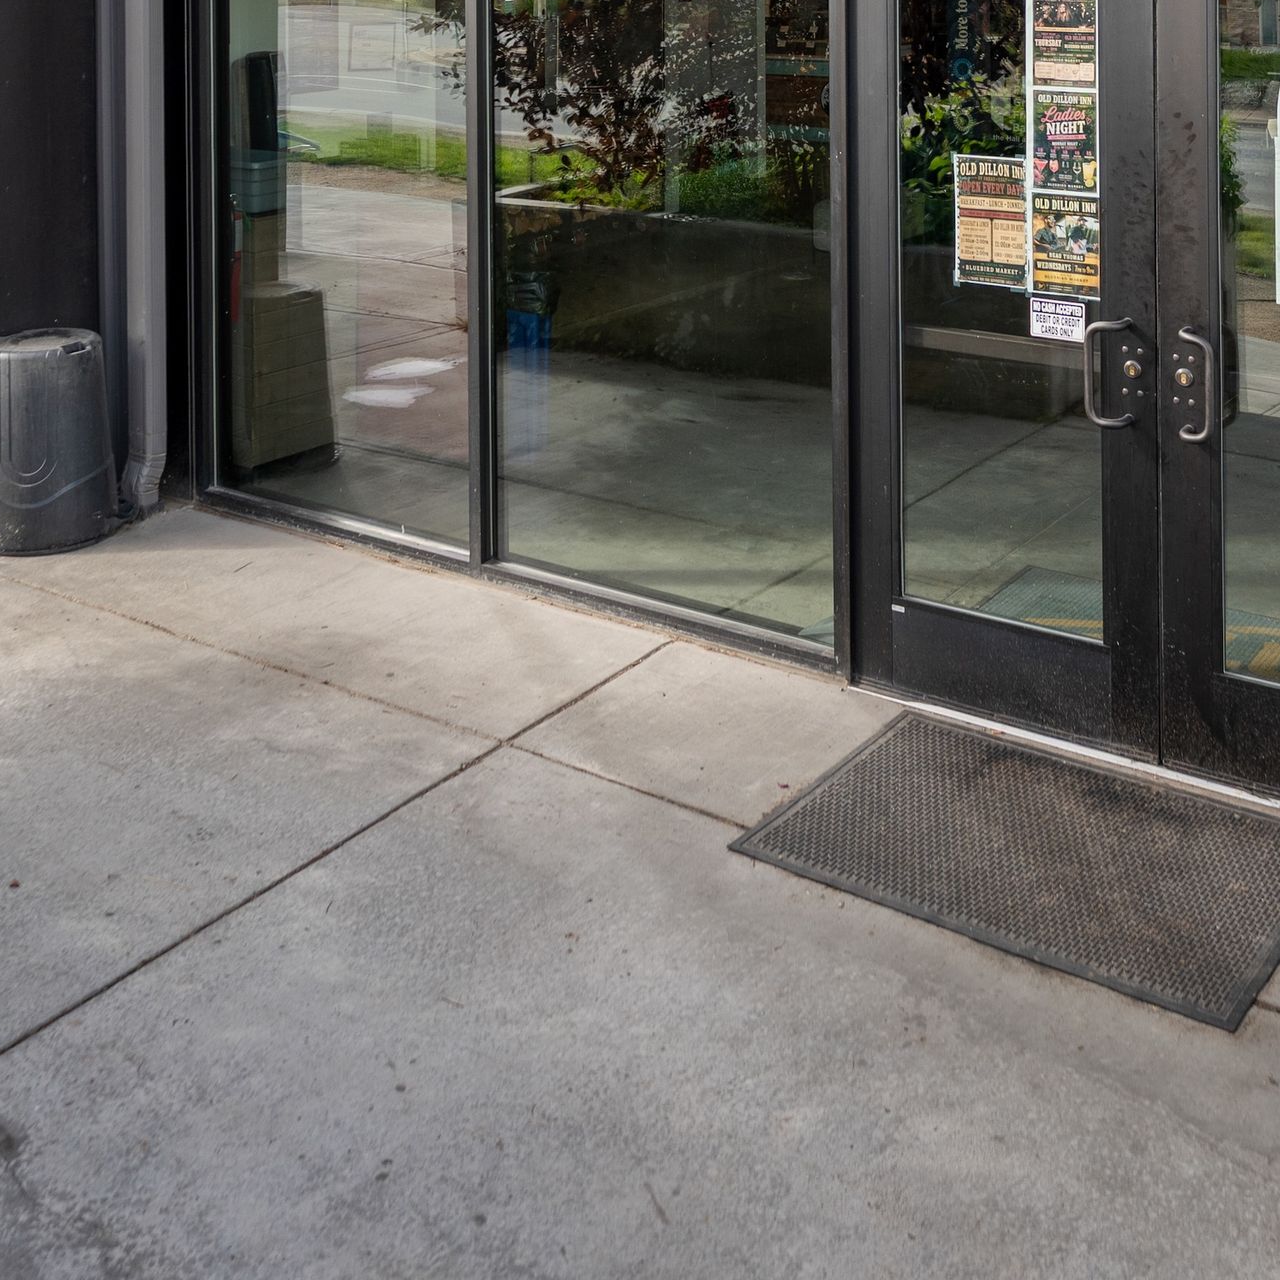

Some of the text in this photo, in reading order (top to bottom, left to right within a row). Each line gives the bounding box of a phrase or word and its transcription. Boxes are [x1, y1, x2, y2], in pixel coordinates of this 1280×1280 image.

[957, 0, 968, 14] to
[955, 16, 969, 50] More
[1034, 38, 1063, 47] THURSDAY
[1038, 94, 1093, 105] OLD DILLON INN
[1041, 106, 1086, 122] Ladies
[1046, 120, 1086, 135] NIGHT
[960, 162, 977, 176] OLD
[979, 162, 1010, 178] DILLON
[962, 180, 980, 193] OPEN
[982, 182, 1005, 194] EVERY
[960, 197, 986, 207] BREAKFAST
[988, 199, 1004, 208] LUNCH
[1034, 197, 1097, 214] OLD DILLON INN
[1062, 253, 1084, 261] THOMAS
[966, 264, 1019, 275] BLUEBIRD MARKET
[1036, 261, 1072, 272] WEDNESDAYS
[1032, 301, 1082, 317] NO CASH ACCEPTED
[1036, 313, 1080, 328] DEBIT OR CREDIT
[1041, 324, 1074, 337] CARDS ONLY
